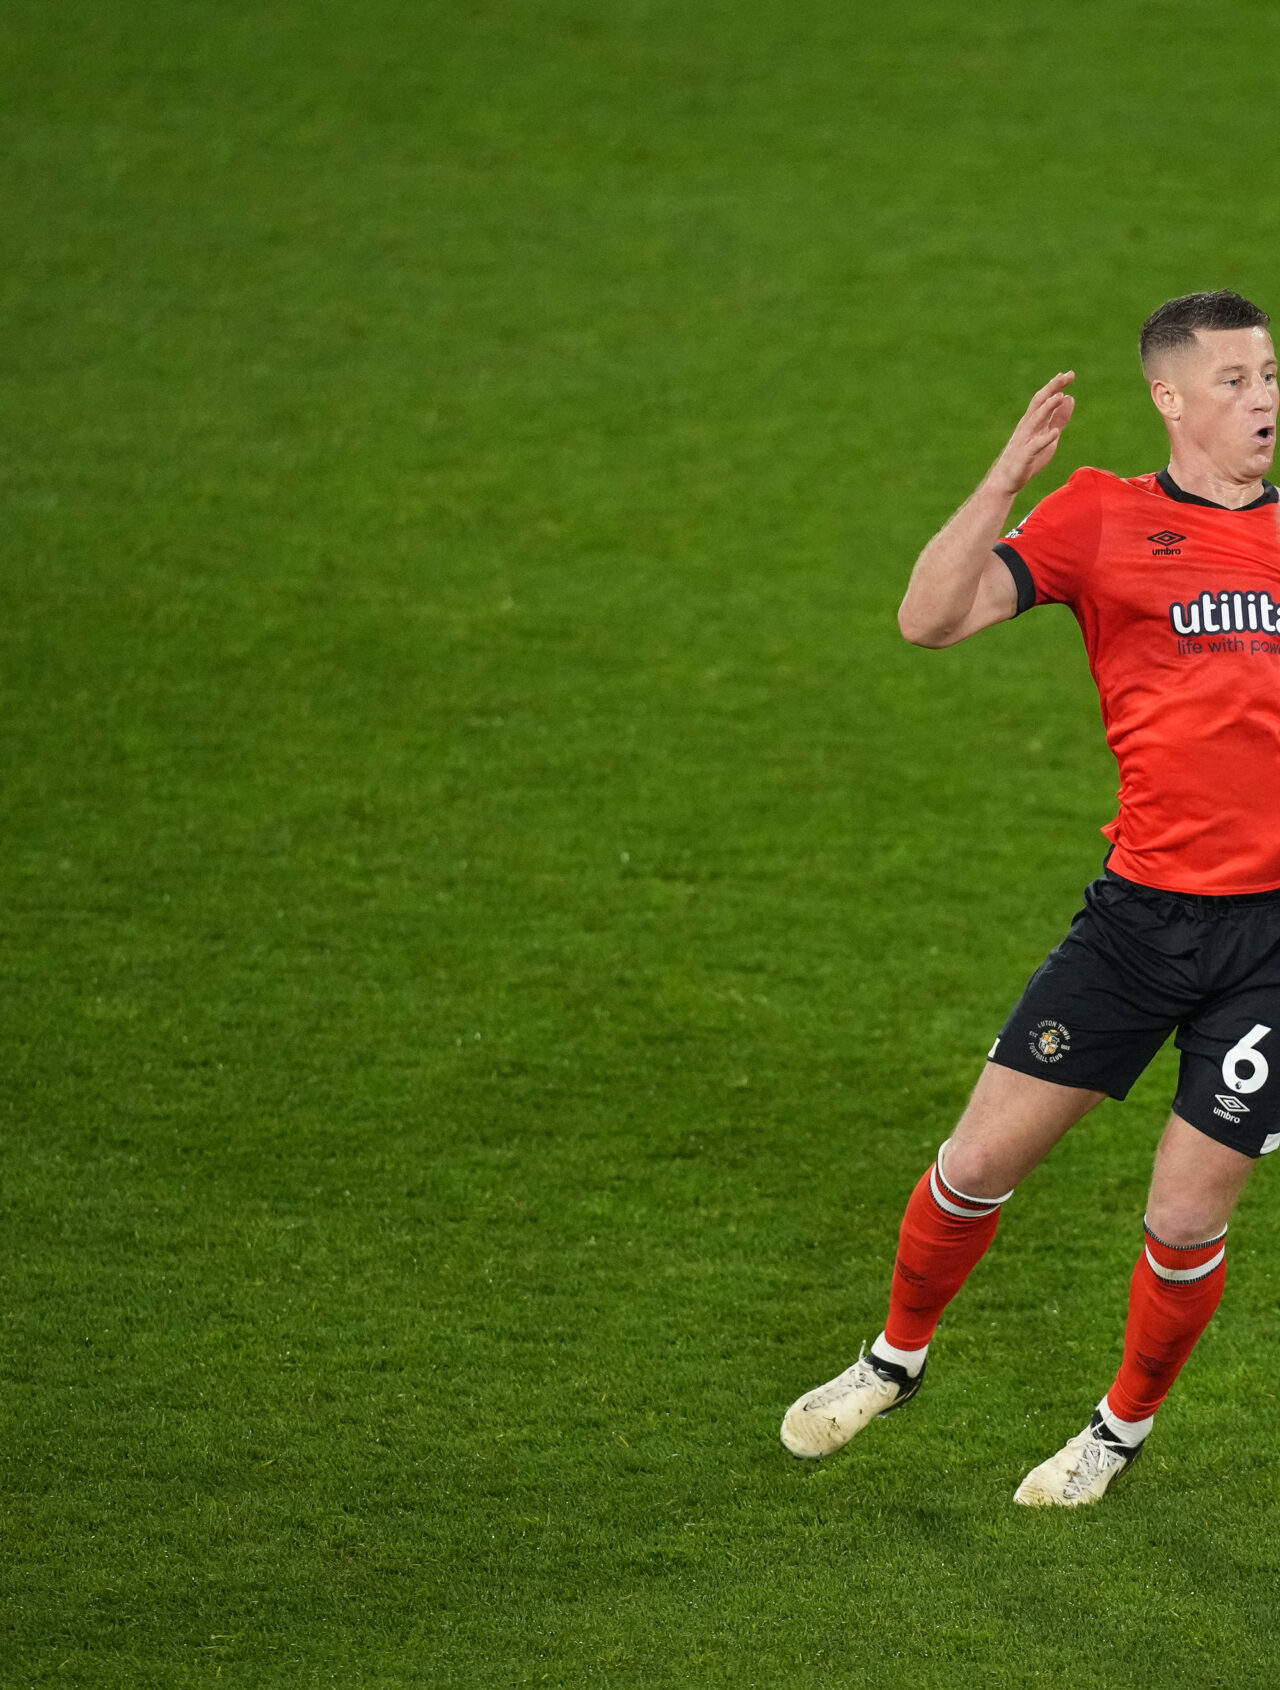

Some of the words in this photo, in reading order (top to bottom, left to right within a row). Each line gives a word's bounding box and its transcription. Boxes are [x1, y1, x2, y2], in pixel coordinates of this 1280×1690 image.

[1151, 547, 1182, 555] umbro
[1177, 640, 1203, 655] life
[1207, 637, 1245, 654] with
[1037, 1020, 1058, 1029] LUTON
[1057, 1023, 1071, 1042] TOWN
[1028, 1042, 1049, 1064] FOOTBALL
[1048, 1052, 1064, 1063] CLUB
[1221, 1023, 1273, 1095] 6
[1212, 1106, 1241, 1125] umbro
